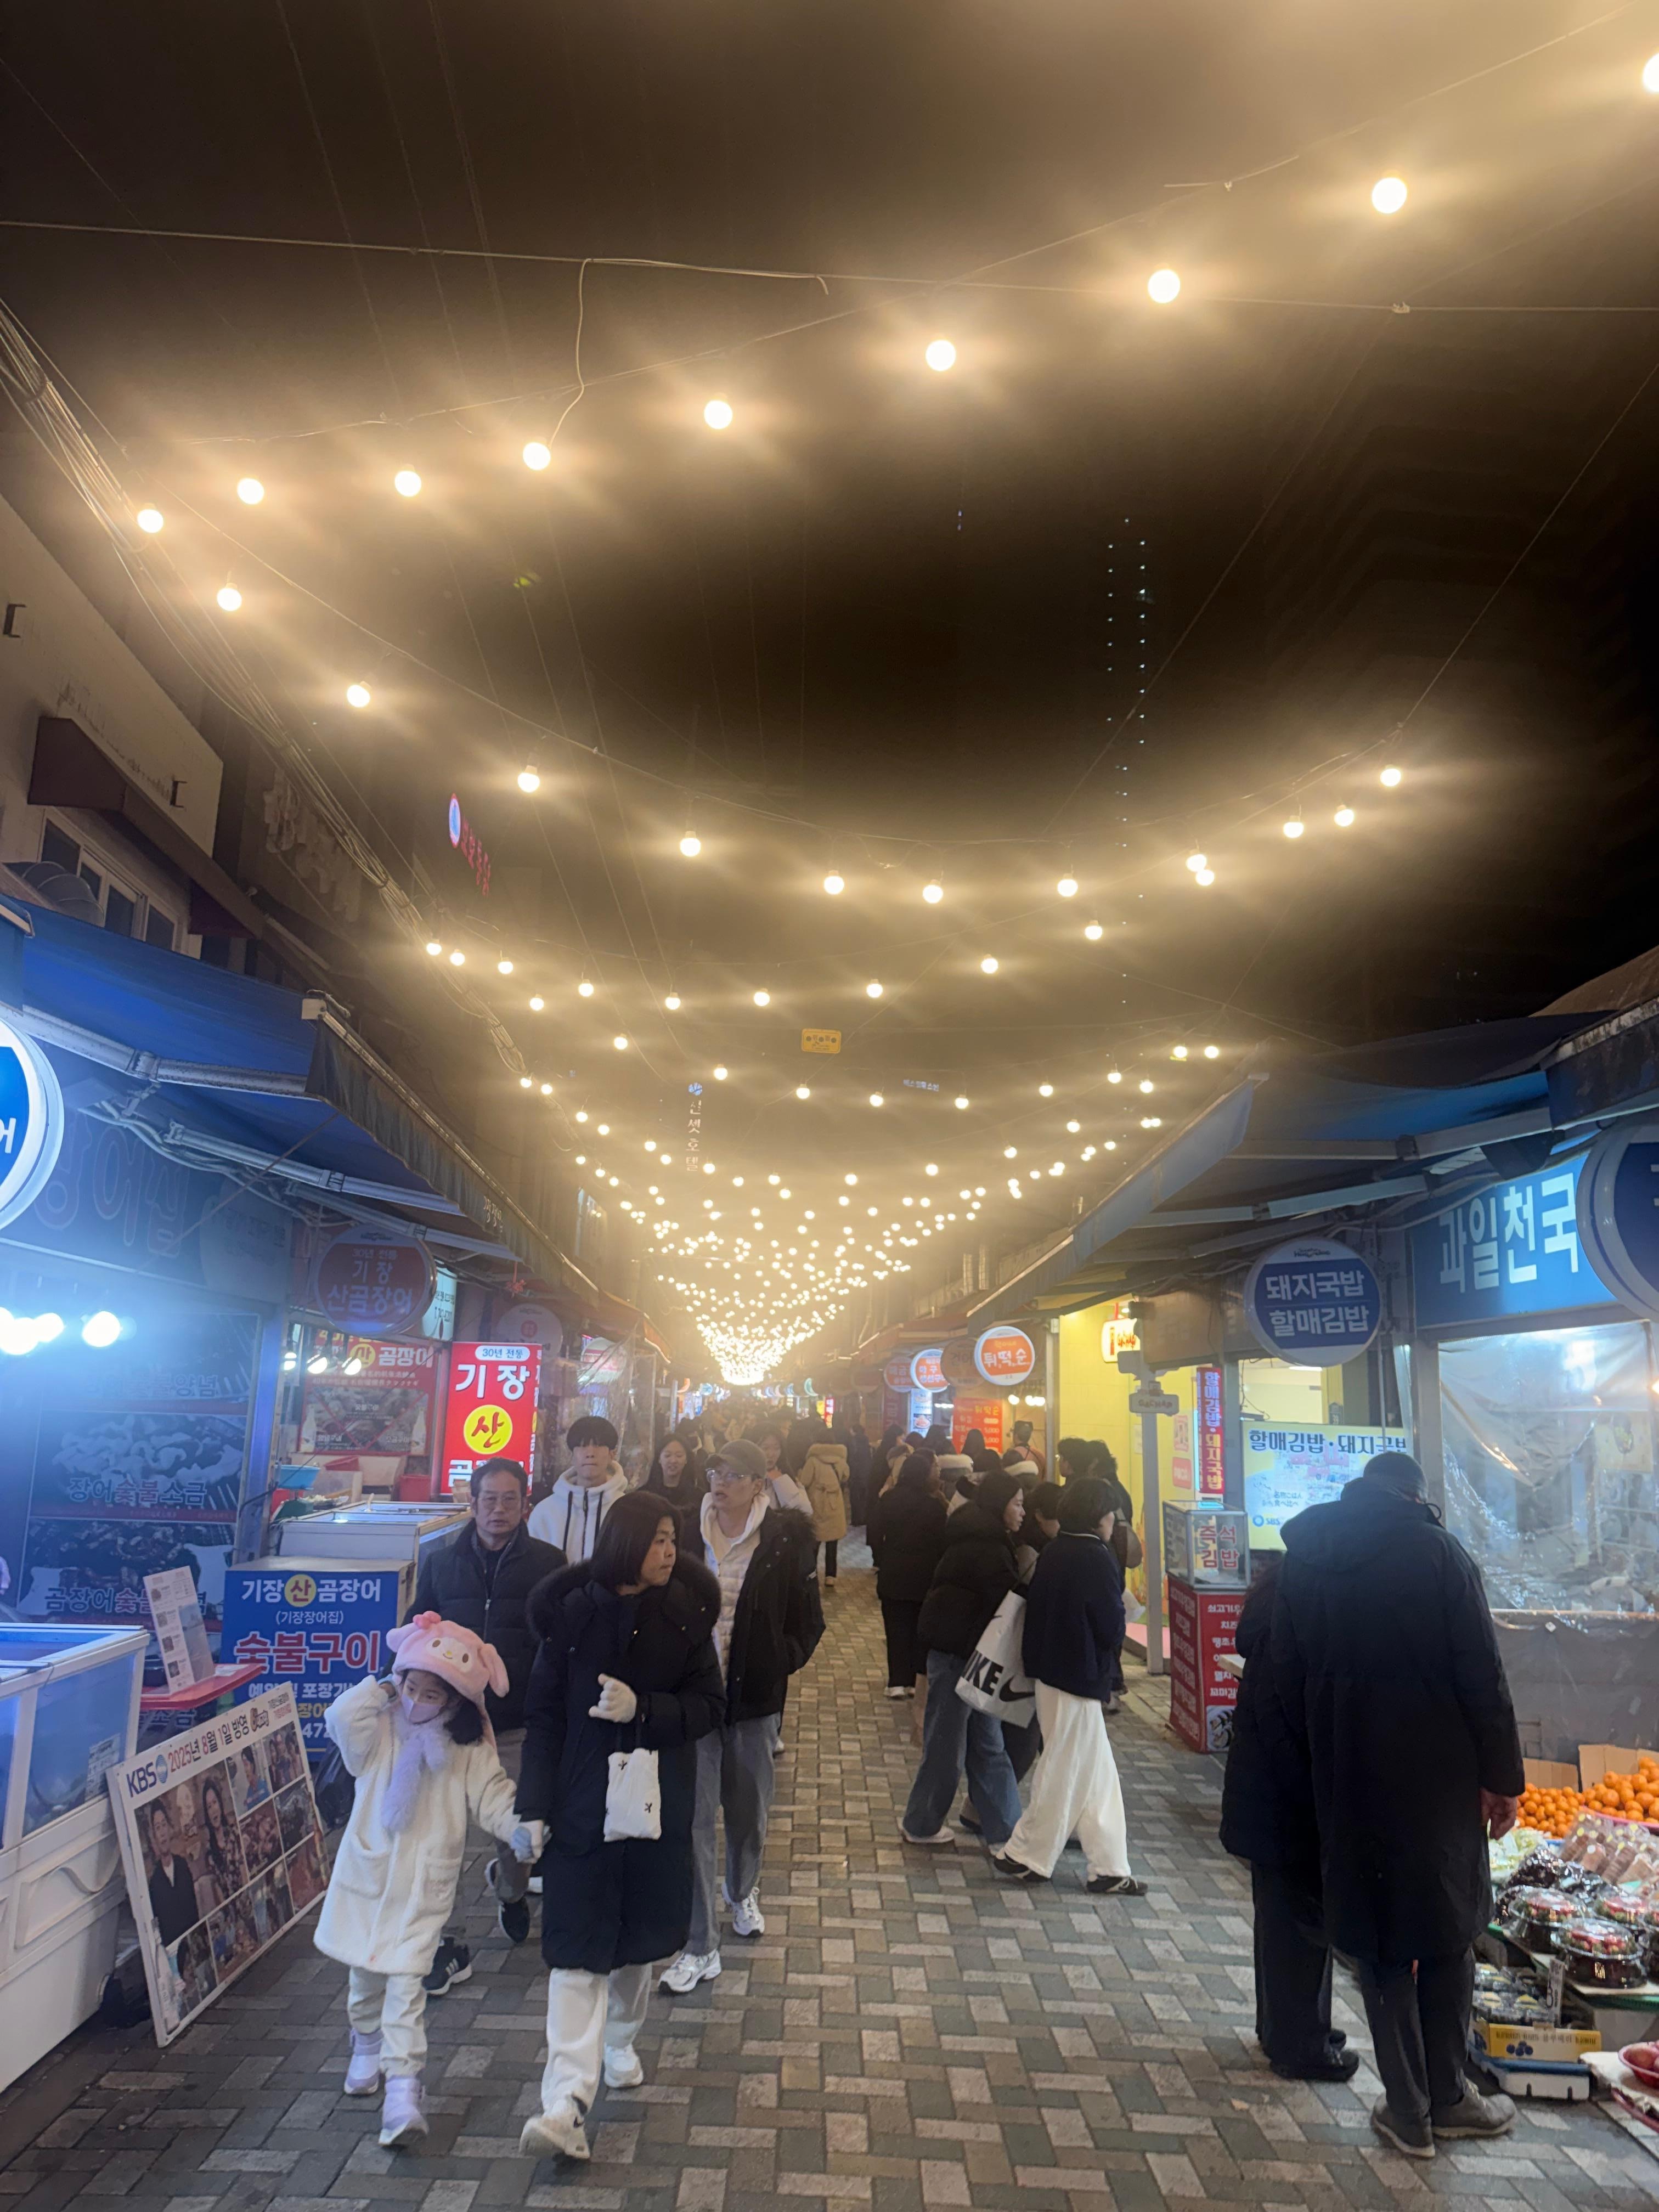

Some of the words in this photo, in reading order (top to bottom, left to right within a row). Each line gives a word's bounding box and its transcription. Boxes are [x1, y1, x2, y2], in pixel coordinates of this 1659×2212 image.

[1438, 1172, 1579, 1294] 과일천국
[352, 1260, 393, 1284] 기장
[1265, 1269, 1365, 1302] 돼지국밥
[326, 1284, 413, 1316] 산곰장어
[1268, 1304, 1369, 1338] 할매김밥
[482, 1348, 503, 1358] 30년
[505, 1349, 524, 1359] 전통
[455, 1364, 531, 1401] 기장
[471, 1411, 505, 1448] 산
[69, 1476, 207, 1506] 장어숯불소금
[1199, 1525, 1237, 1544] 즉석
[1201, 1549, 1240, 1569] 김밥
[241, 1579, 284, 1603] 기장
[290, 1579, 312, 1602] 산
[317, 1578, 381, 1603] 곰장어
[275, 1611, 345, 1625] (기장장어집)
[126, 1763, 157, 1798] KBS
[168, 1738, 201, 1773] 2025년
[201, 1730, 218, 1756] 8월
[217, 1724, 233, 1746] 1일
[232, 1713, 249, 1741] 방영
